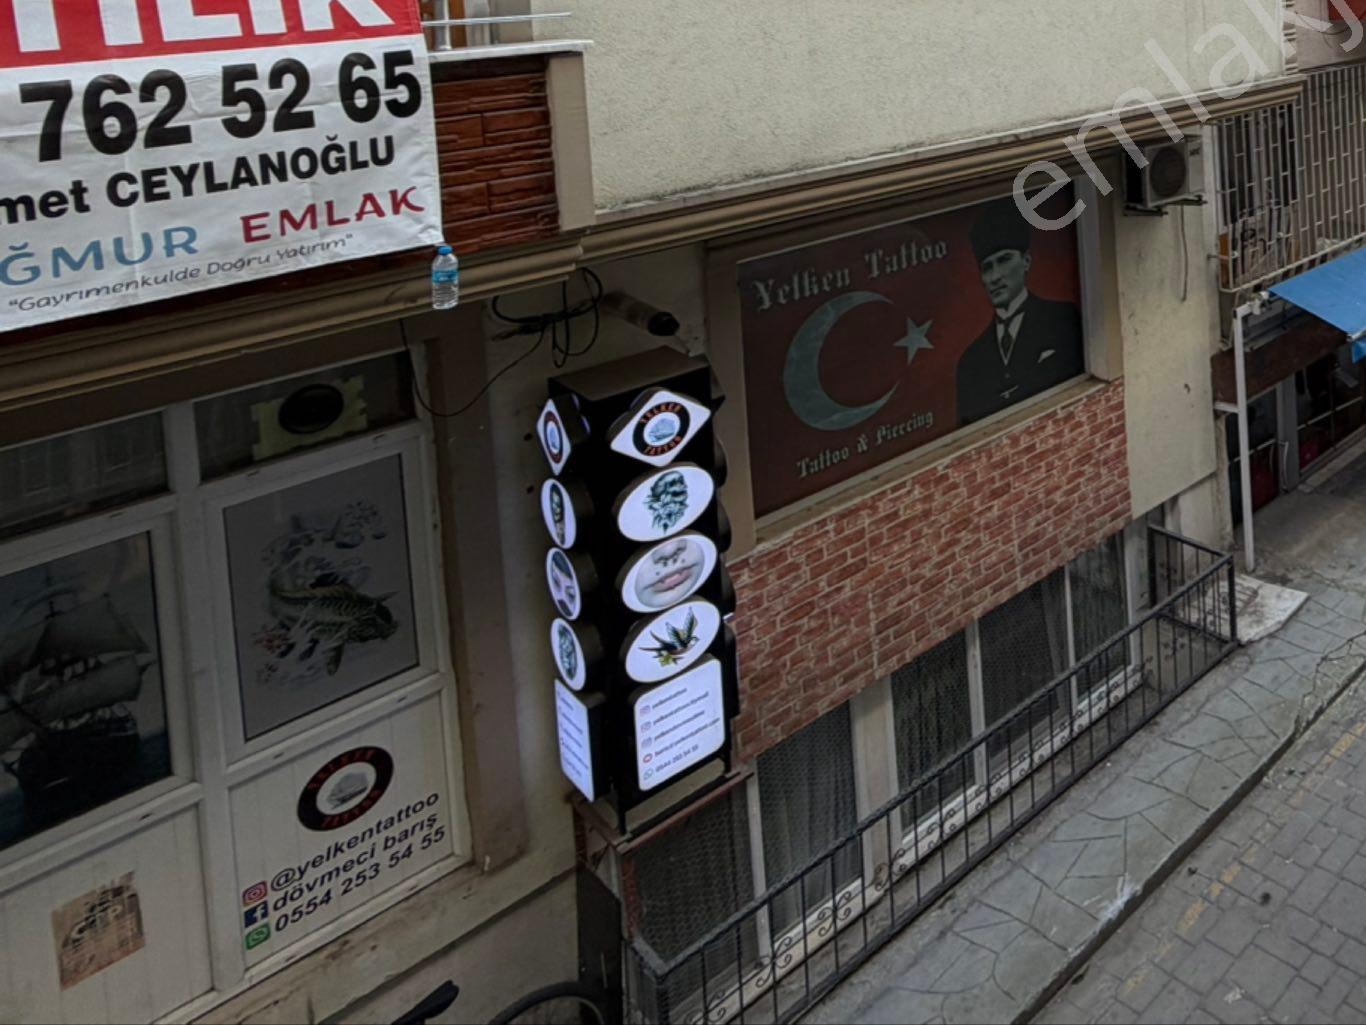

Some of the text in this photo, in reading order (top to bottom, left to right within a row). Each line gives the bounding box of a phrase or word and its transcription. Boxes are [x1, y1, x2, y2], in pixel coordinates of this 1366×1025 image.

[20, 50, 422, 163] 762 52 65
[106, 133, 395, 207] CEYLANOĞLU
[240, 185, 425, 244] EMLAK
[207, 253, 271, 276] Doğru
[752, 239, 948, 313] Yelken Tattoo
[796, 445, 850, 479] Tattoo
[874, 410, 934, 446] Piercing
[271, 792, 440, 892] @yelkentattoo
[272, 813, 438, 911] dövmeci barış
[275, 825, 446, 932] 0554 253 54 55
